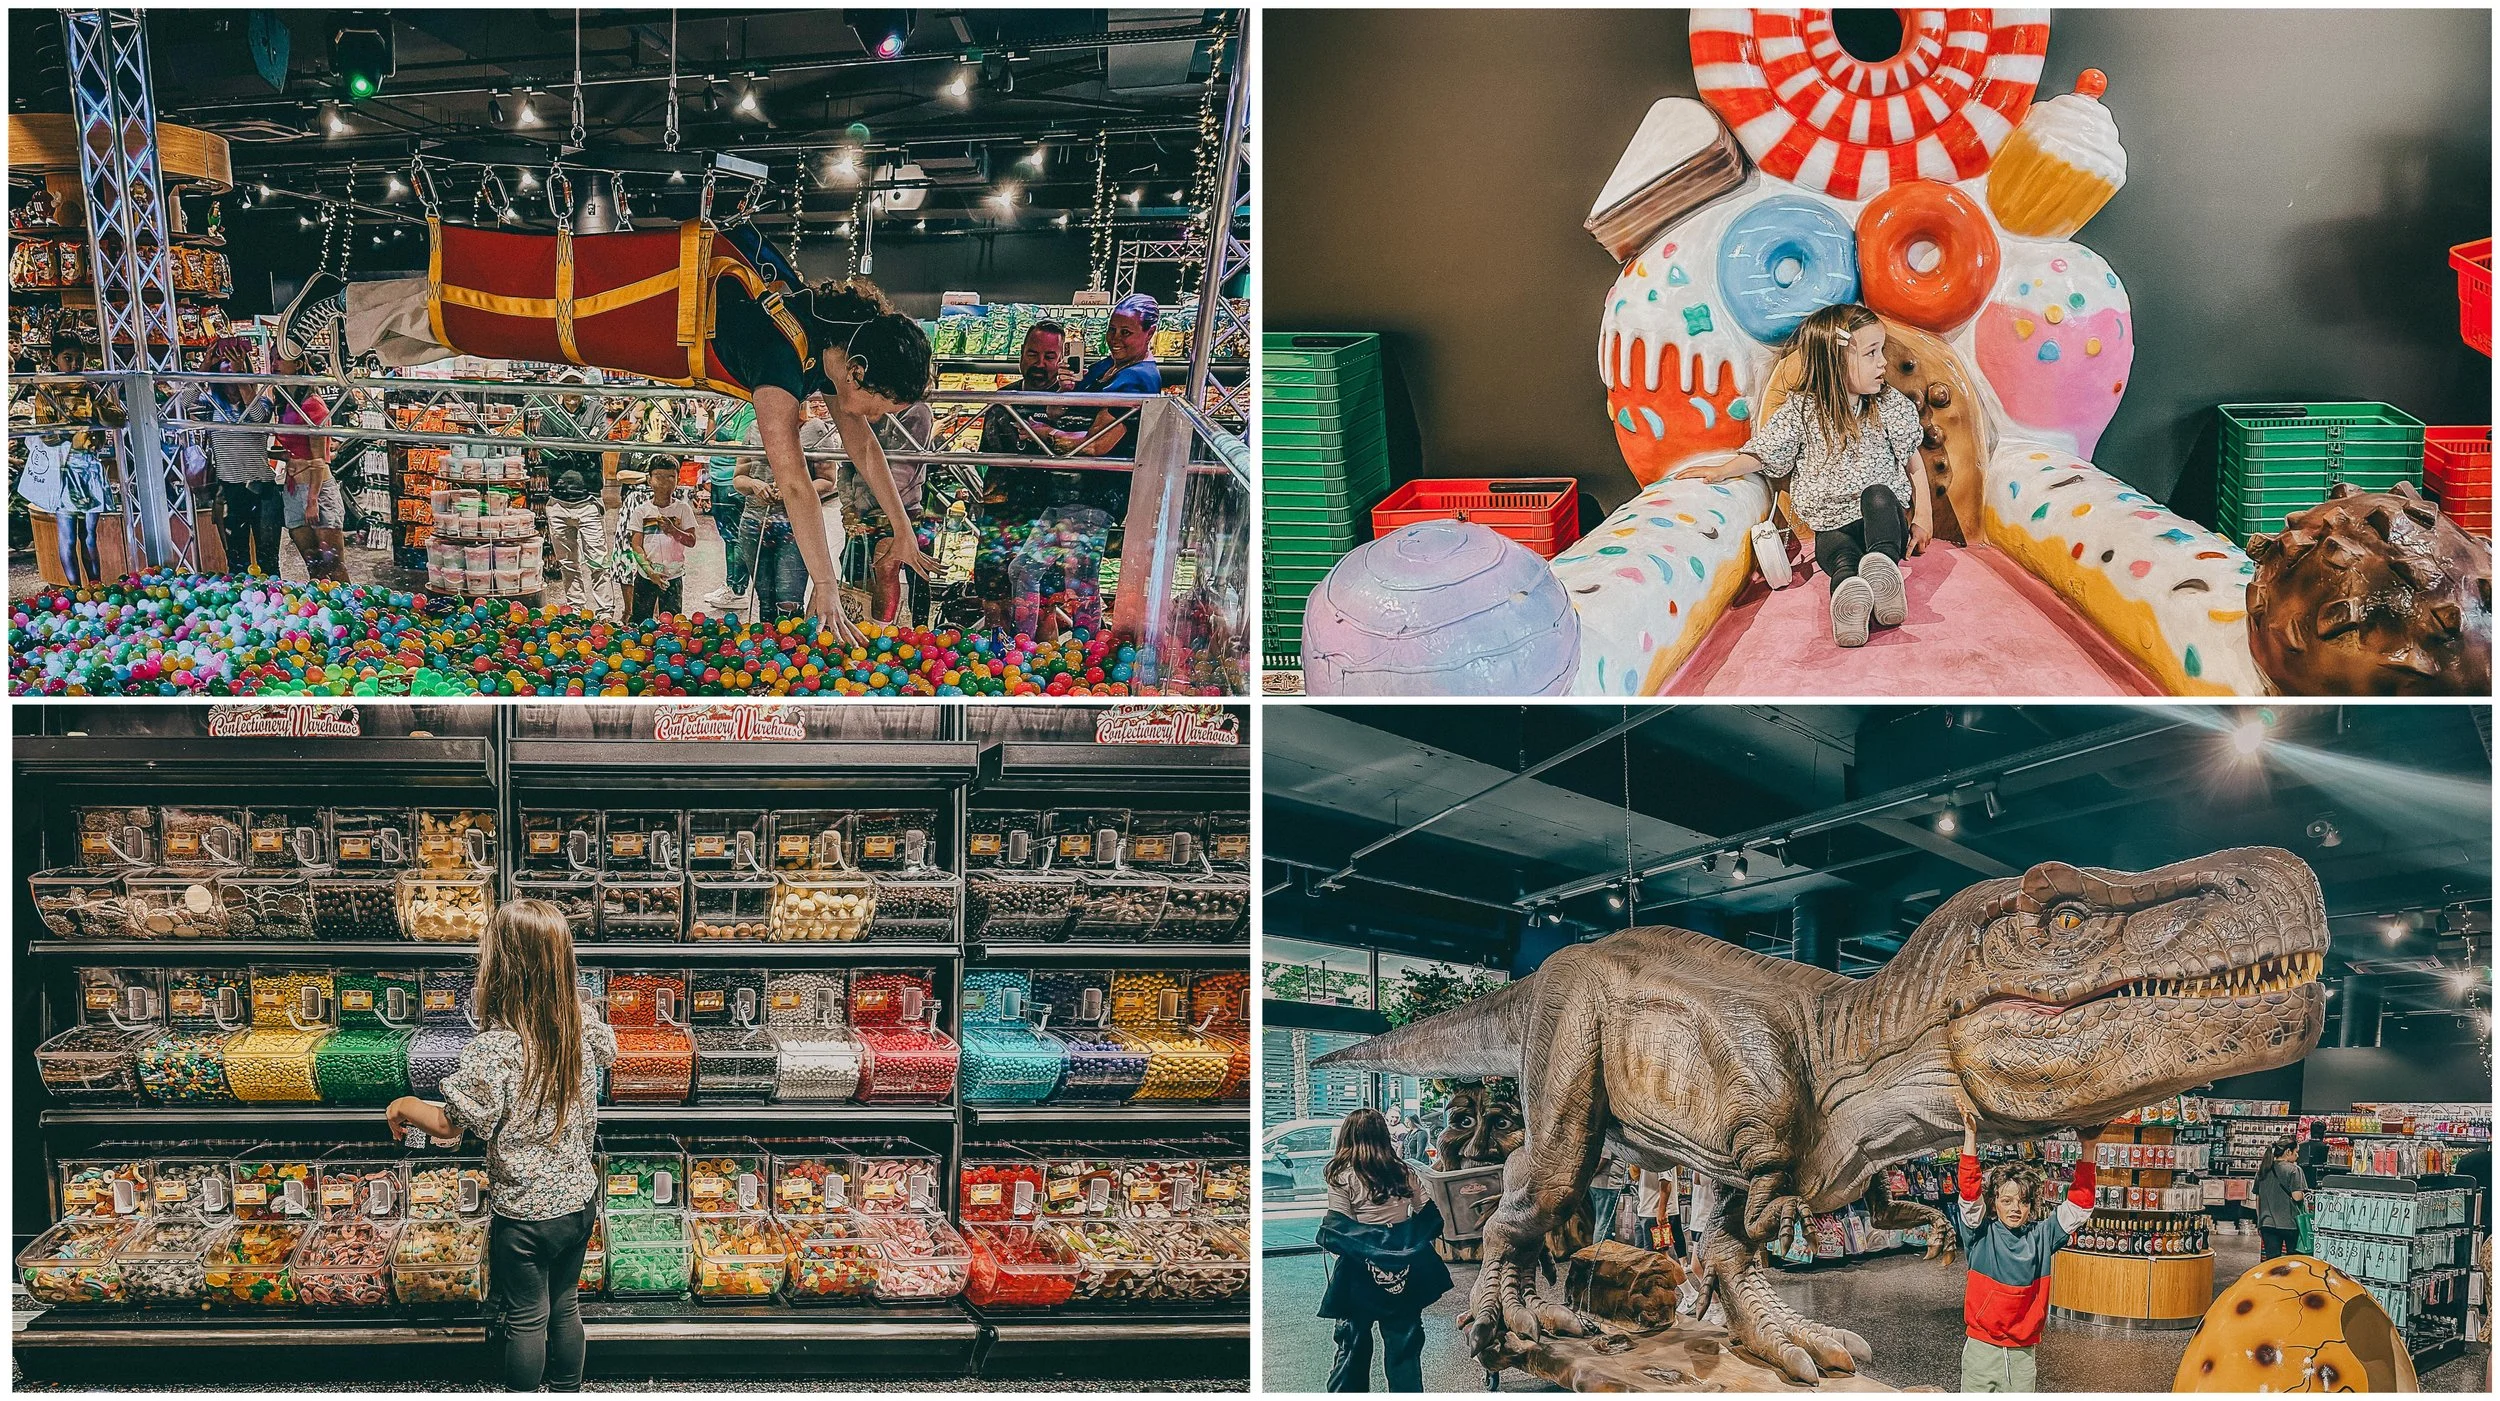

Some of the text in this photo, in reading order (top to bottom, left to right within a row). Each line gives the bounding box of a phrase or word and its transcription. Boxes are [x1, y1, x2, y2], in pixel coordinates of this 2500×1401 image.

[211, 706, 358, 736] Confectionery Warehouse
[657, 707, 803, 740] Confectionery Warehouse
[1100, 712, 1237, 744] Confectionery Warehouse
